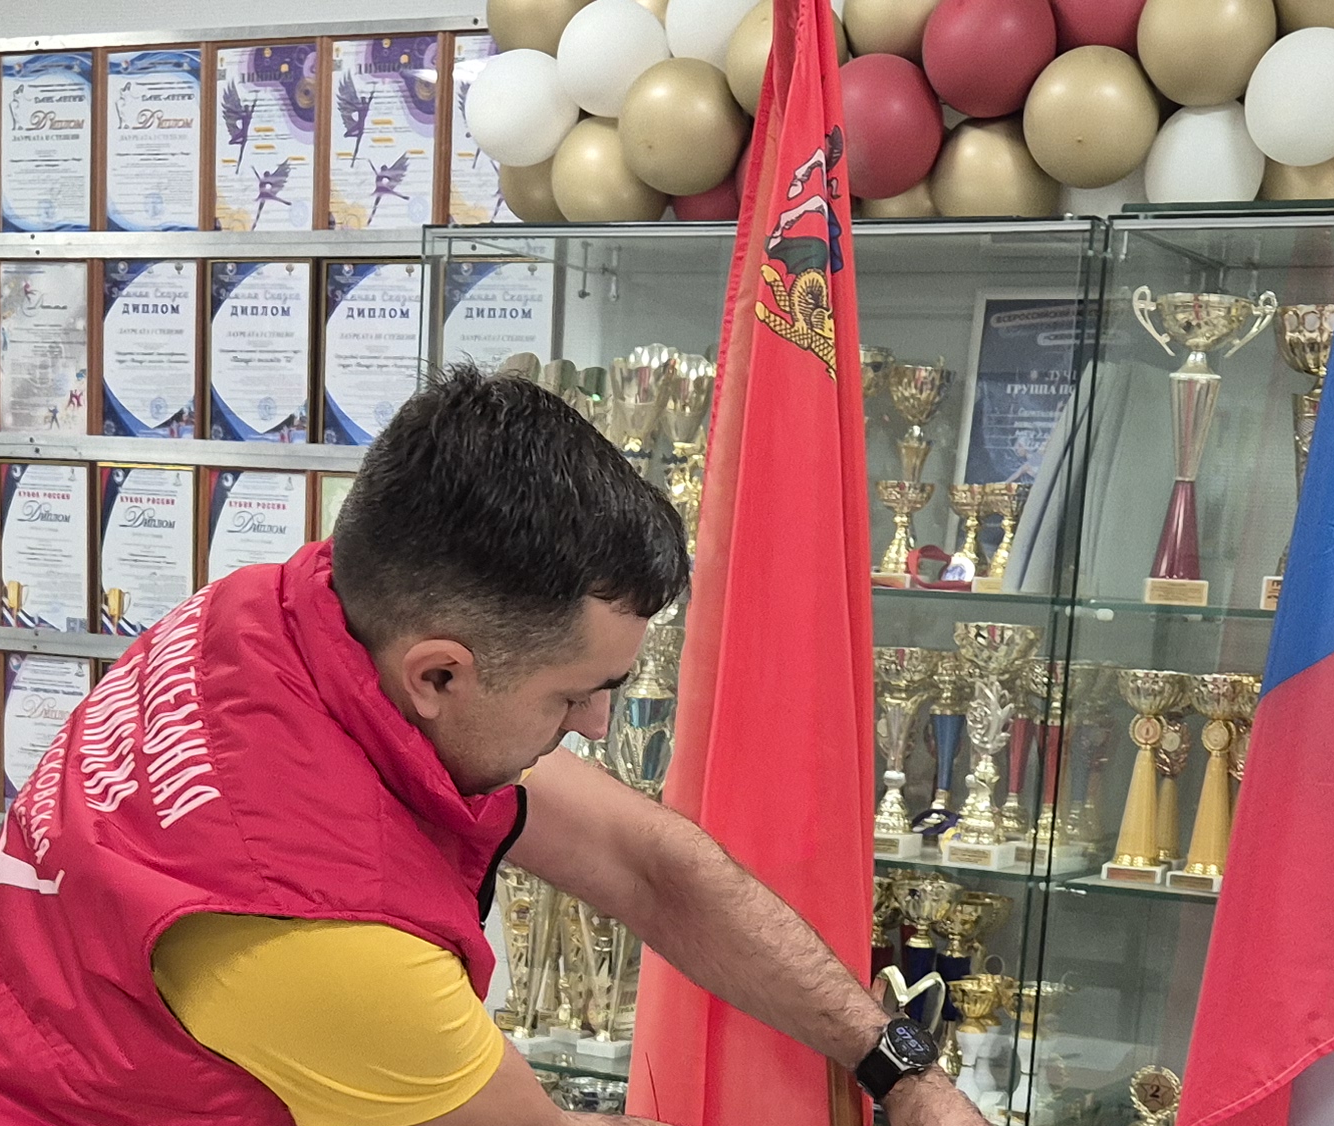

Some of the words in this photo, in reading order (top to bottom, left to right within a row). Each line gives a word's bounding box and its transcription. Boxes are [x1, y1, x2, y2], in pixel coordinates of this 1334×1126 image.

[122, 303, 180, 315] ДИПЛОМ
[230, 306, 292, 317] ДИПЛОМ
[346, 307, 410, 319] ДИПЛОМ
[465, 307, 532, 319] ДИПЛОМ
[1006, 383, 1057, 395] ГРУППА
[30, 731, 69, 865] ОСКОВСКАЯ
[1150, 1085, 1161, 1099] 2
